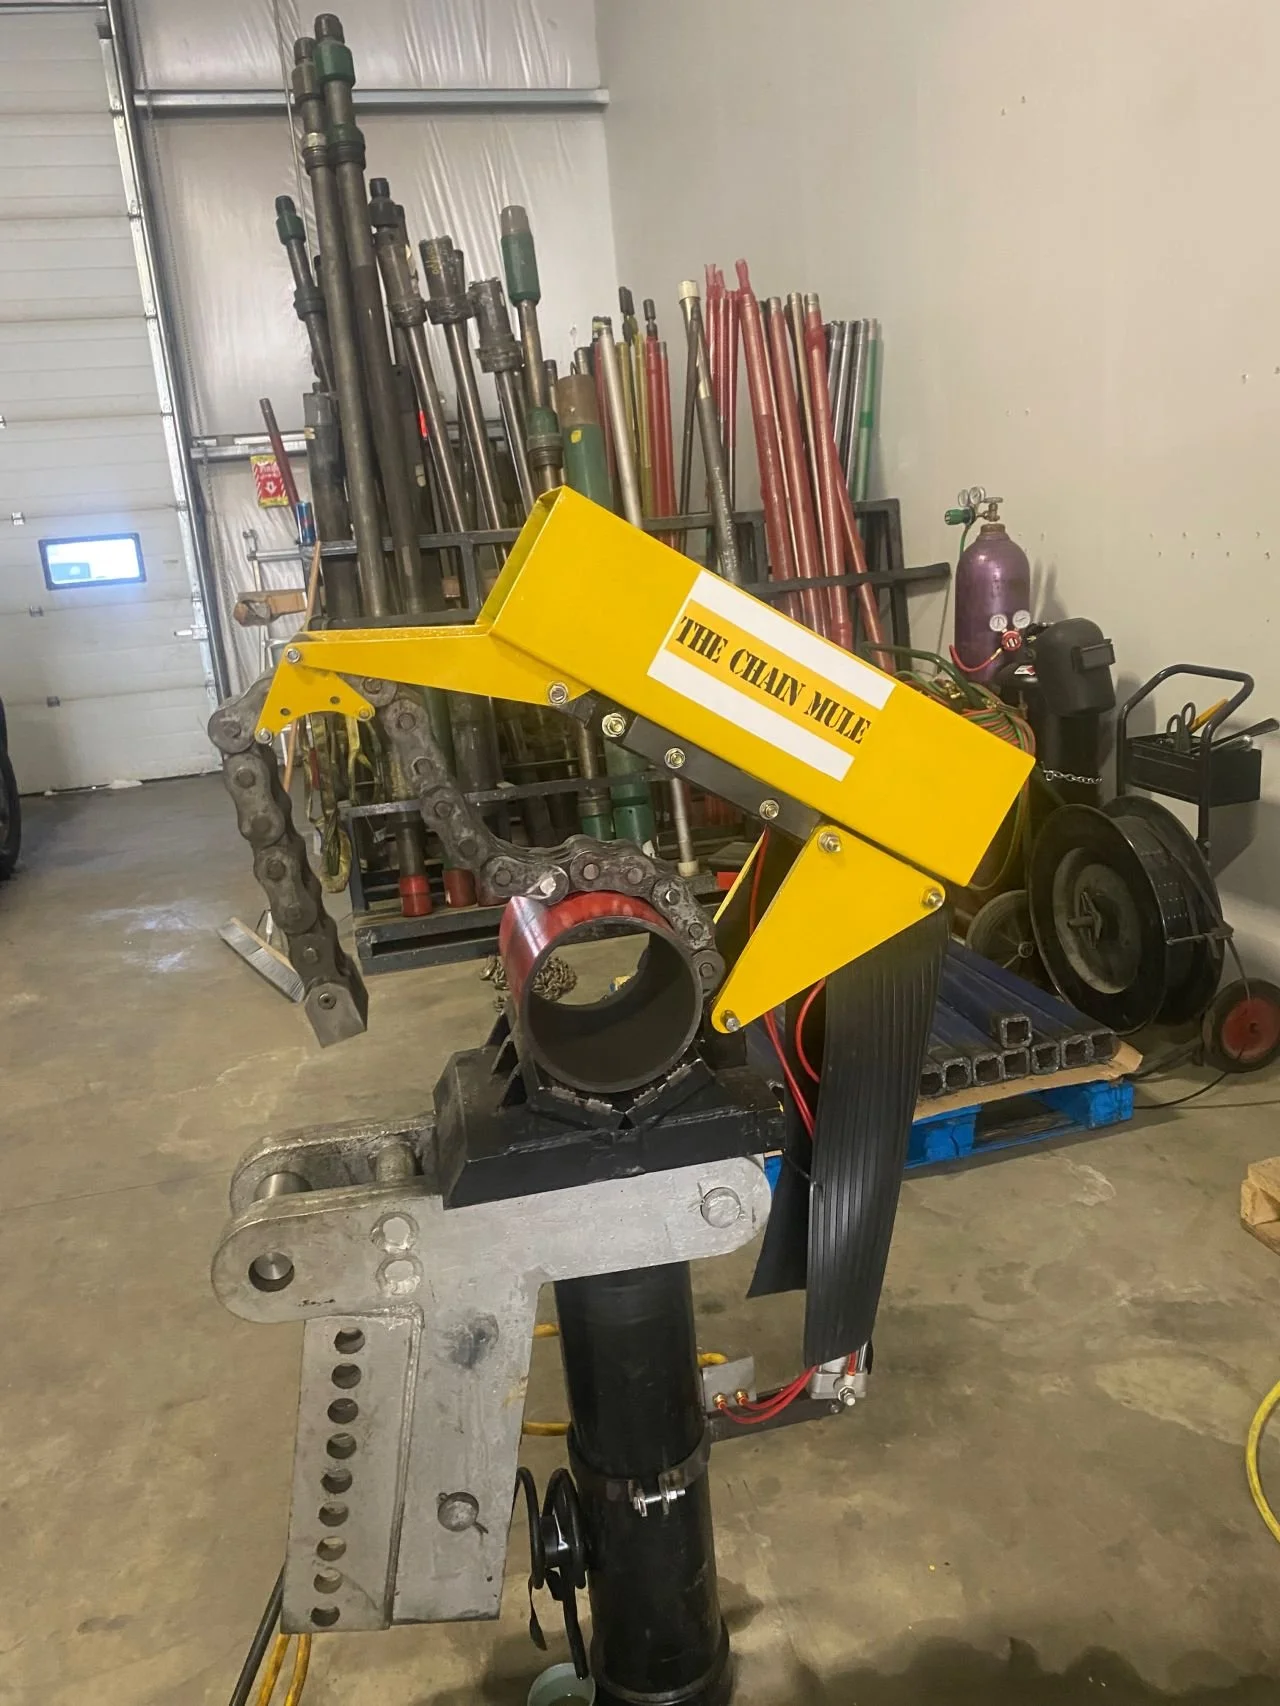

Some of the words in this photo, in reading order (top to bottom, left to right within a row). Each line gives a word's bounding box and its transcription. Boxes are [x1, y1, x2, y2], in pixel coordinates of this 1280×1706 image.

[676, 616, 728, 663] THE
[730, 649, 805, 706] CHAIN
[804, 692, 871, 744] MULE
